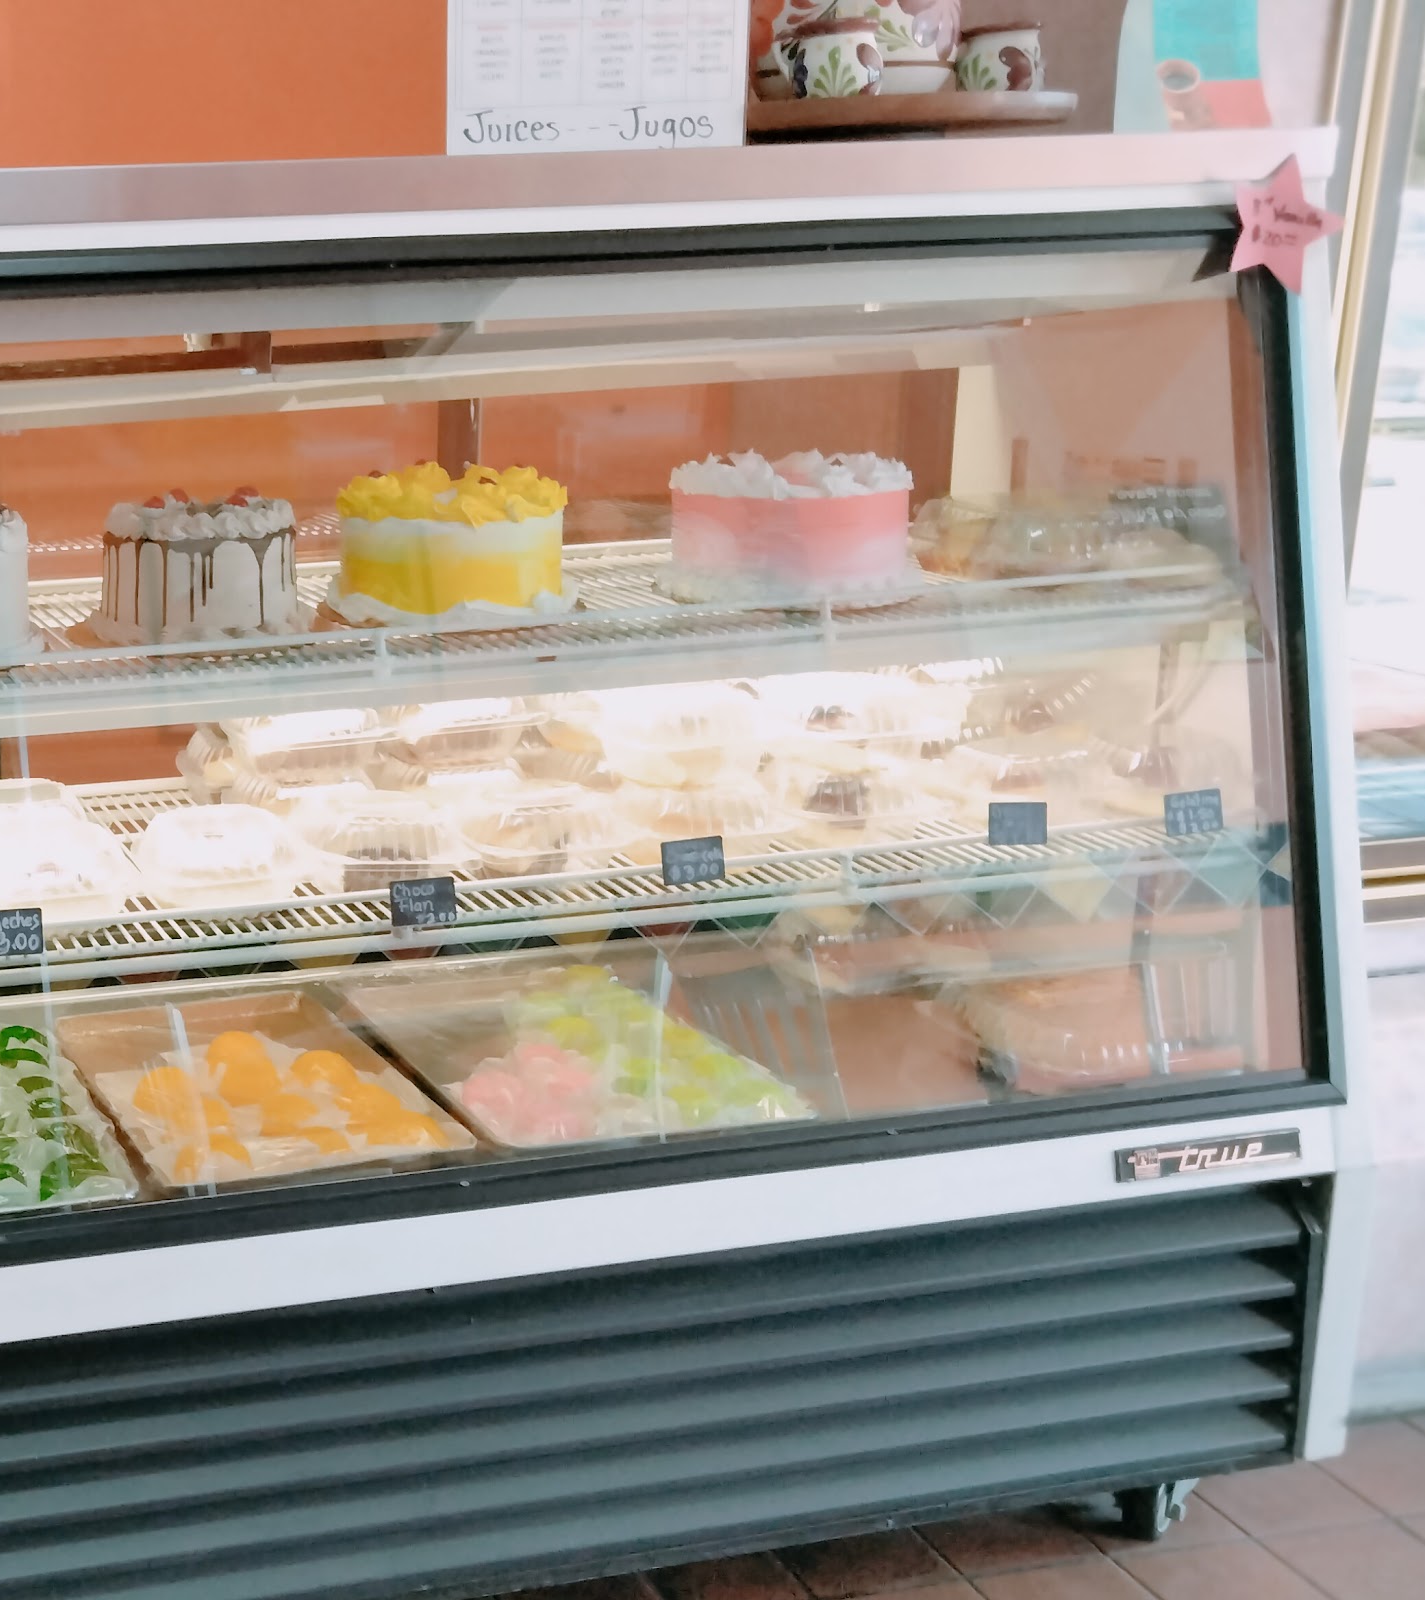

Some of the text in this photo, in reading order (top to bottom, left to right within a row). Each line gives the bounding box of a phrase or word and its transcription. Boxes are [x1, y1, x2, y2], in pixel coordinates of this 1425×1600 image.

[463, 105, 714, 149] Juices Jugos
[394, 897, 435, 913] Flan
